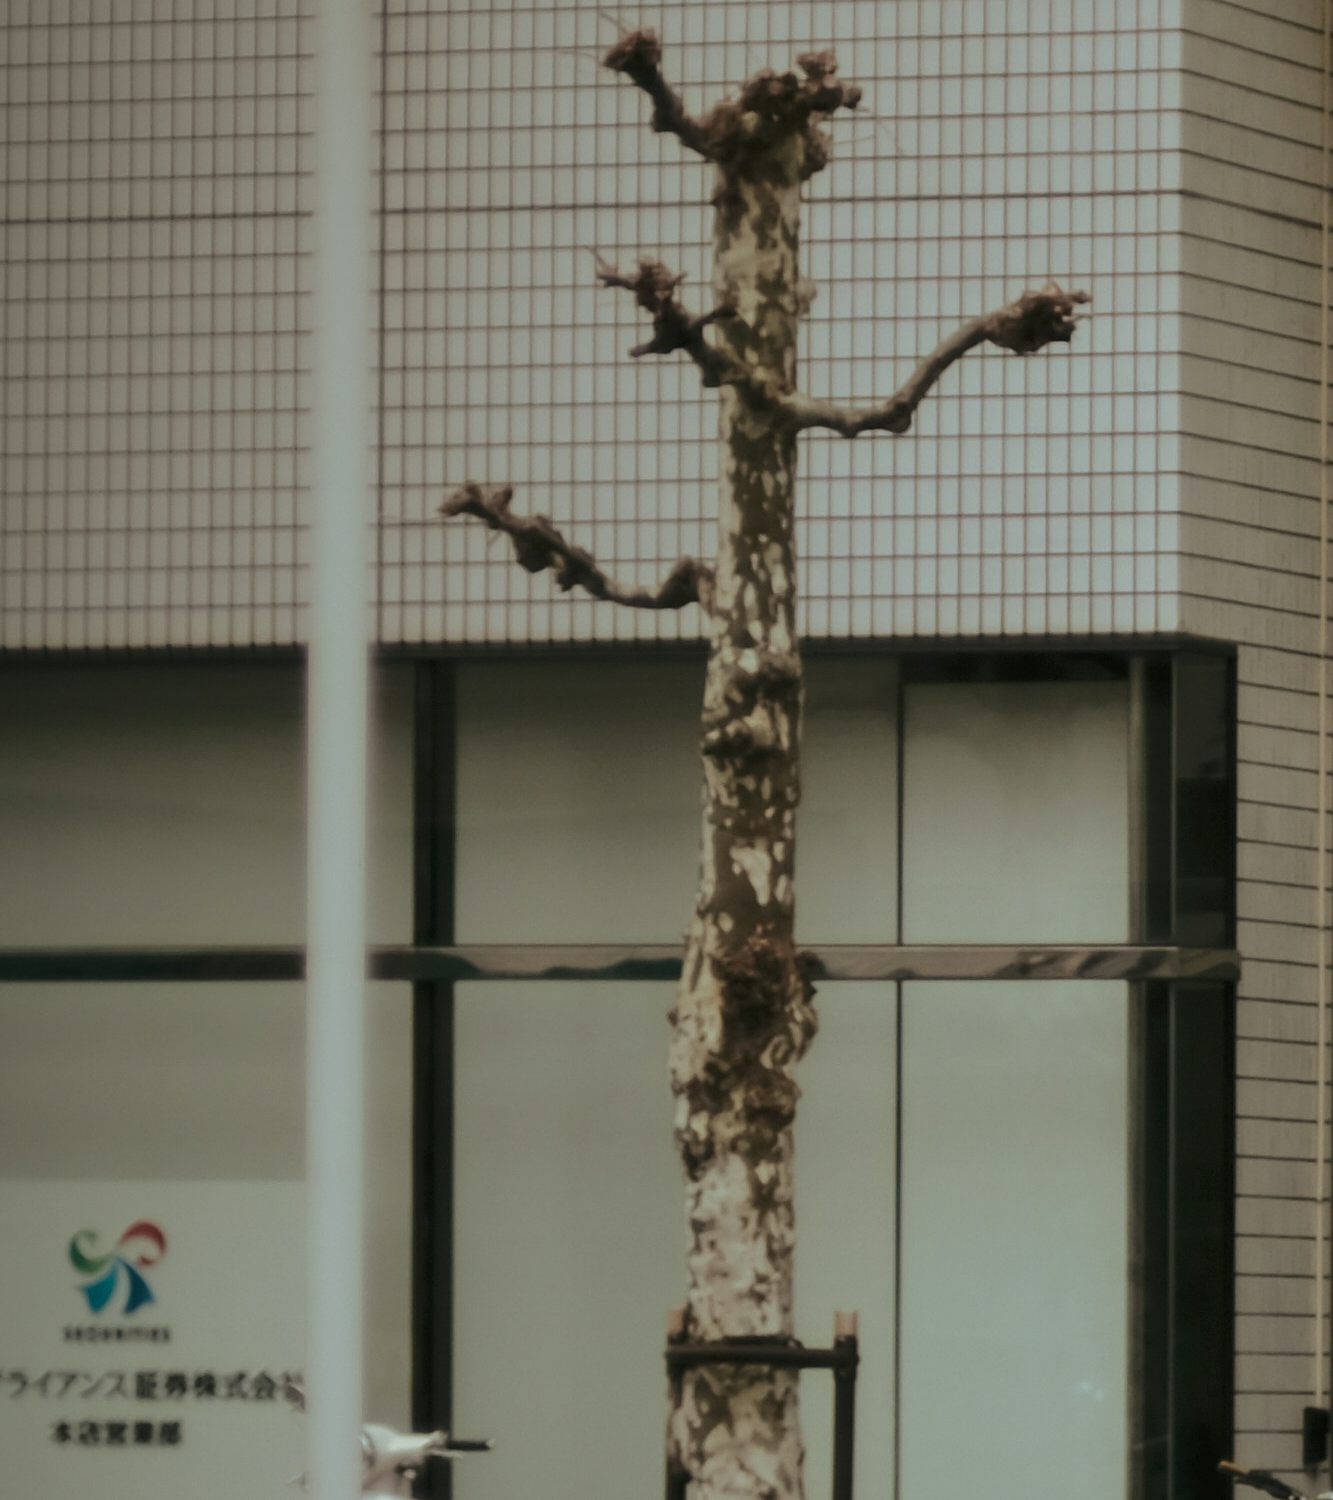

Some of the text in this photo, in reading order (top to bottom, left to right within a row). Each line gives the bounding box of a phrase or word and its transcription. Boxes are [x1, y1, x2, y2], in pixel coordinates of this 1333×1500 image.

[0, 1370, 304, 1401] ライアンス証券株式会
